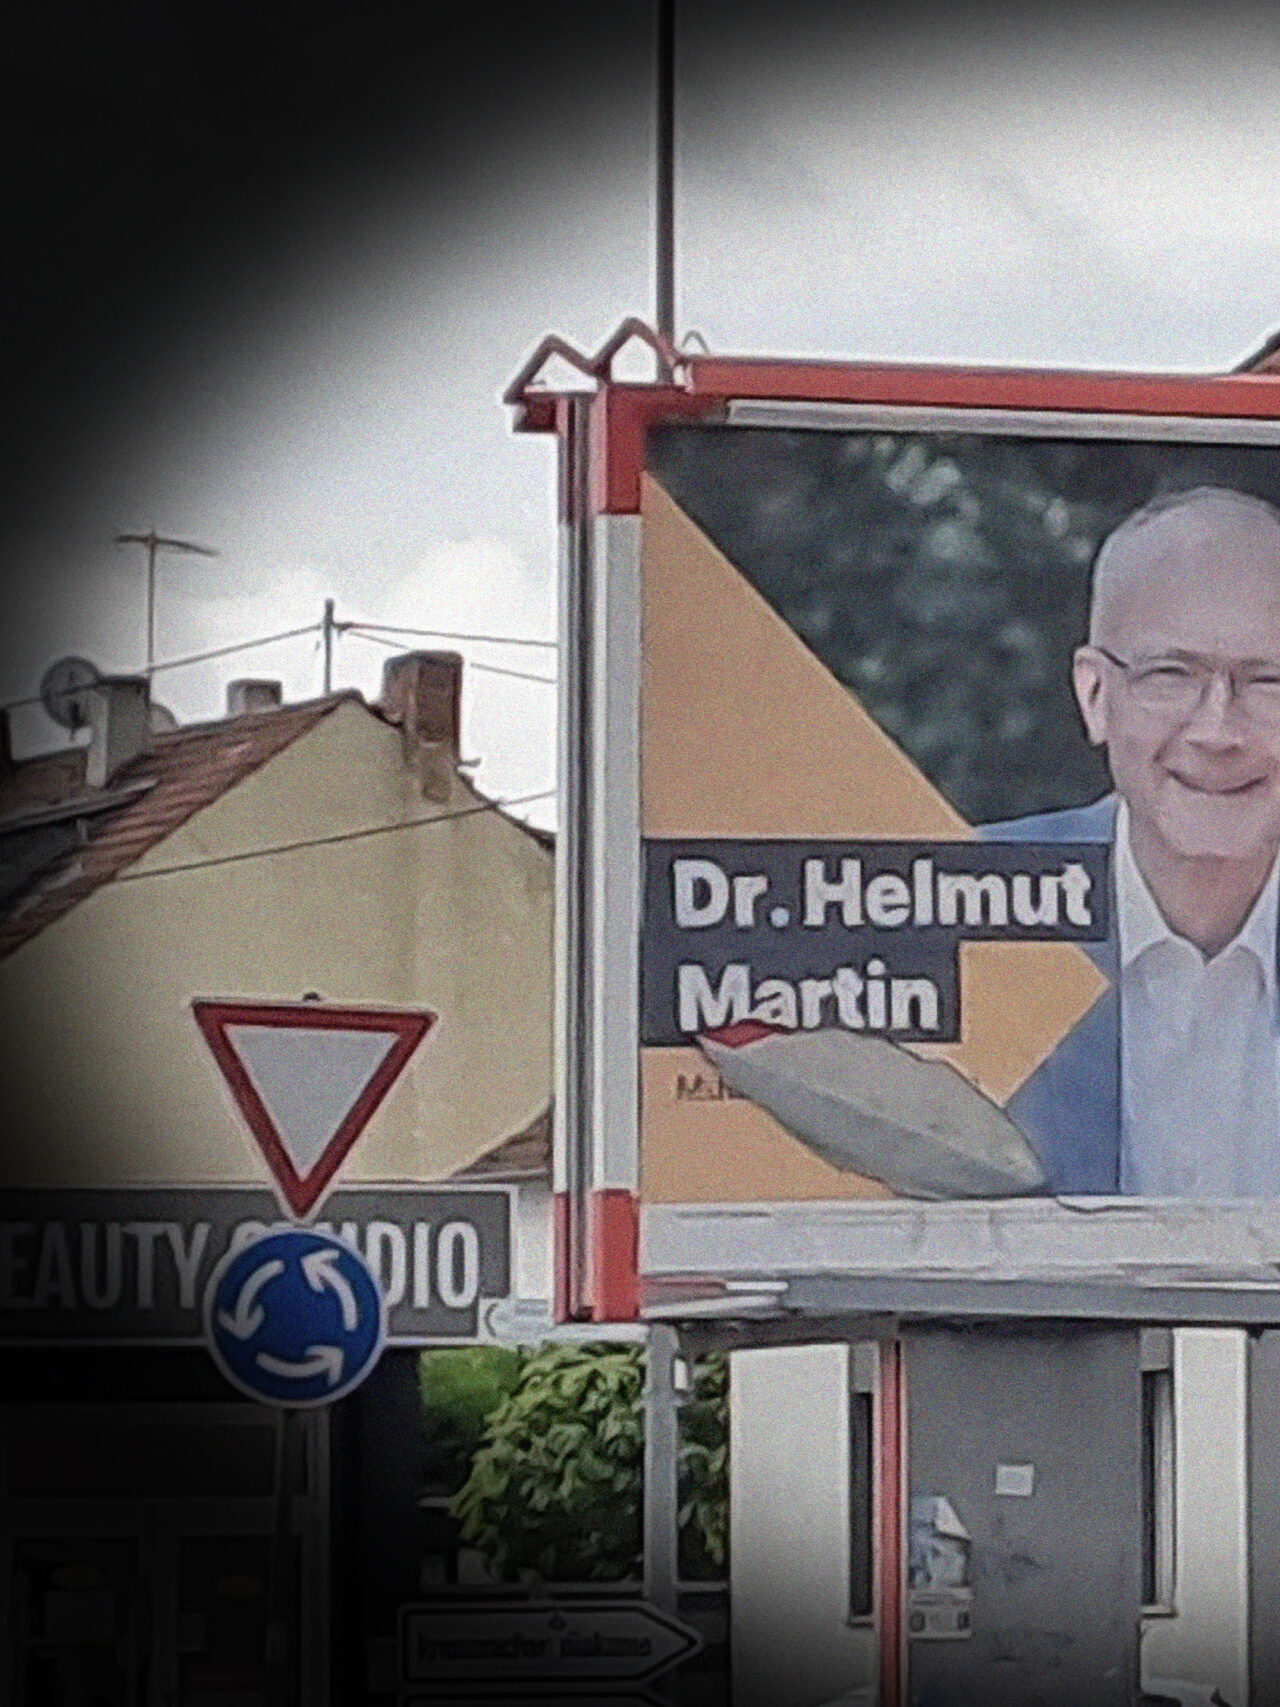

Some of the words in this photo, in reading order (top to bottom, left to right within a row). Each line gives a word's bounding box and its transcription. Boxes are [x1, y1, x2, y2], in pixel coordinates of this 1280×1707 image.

[673, 858, 789, 928] Dr.
[803, 858, 1092, 926] Helmut
[678, 959, 938, 1031] Martin
[228, 1221, 480, 1310] DIO
